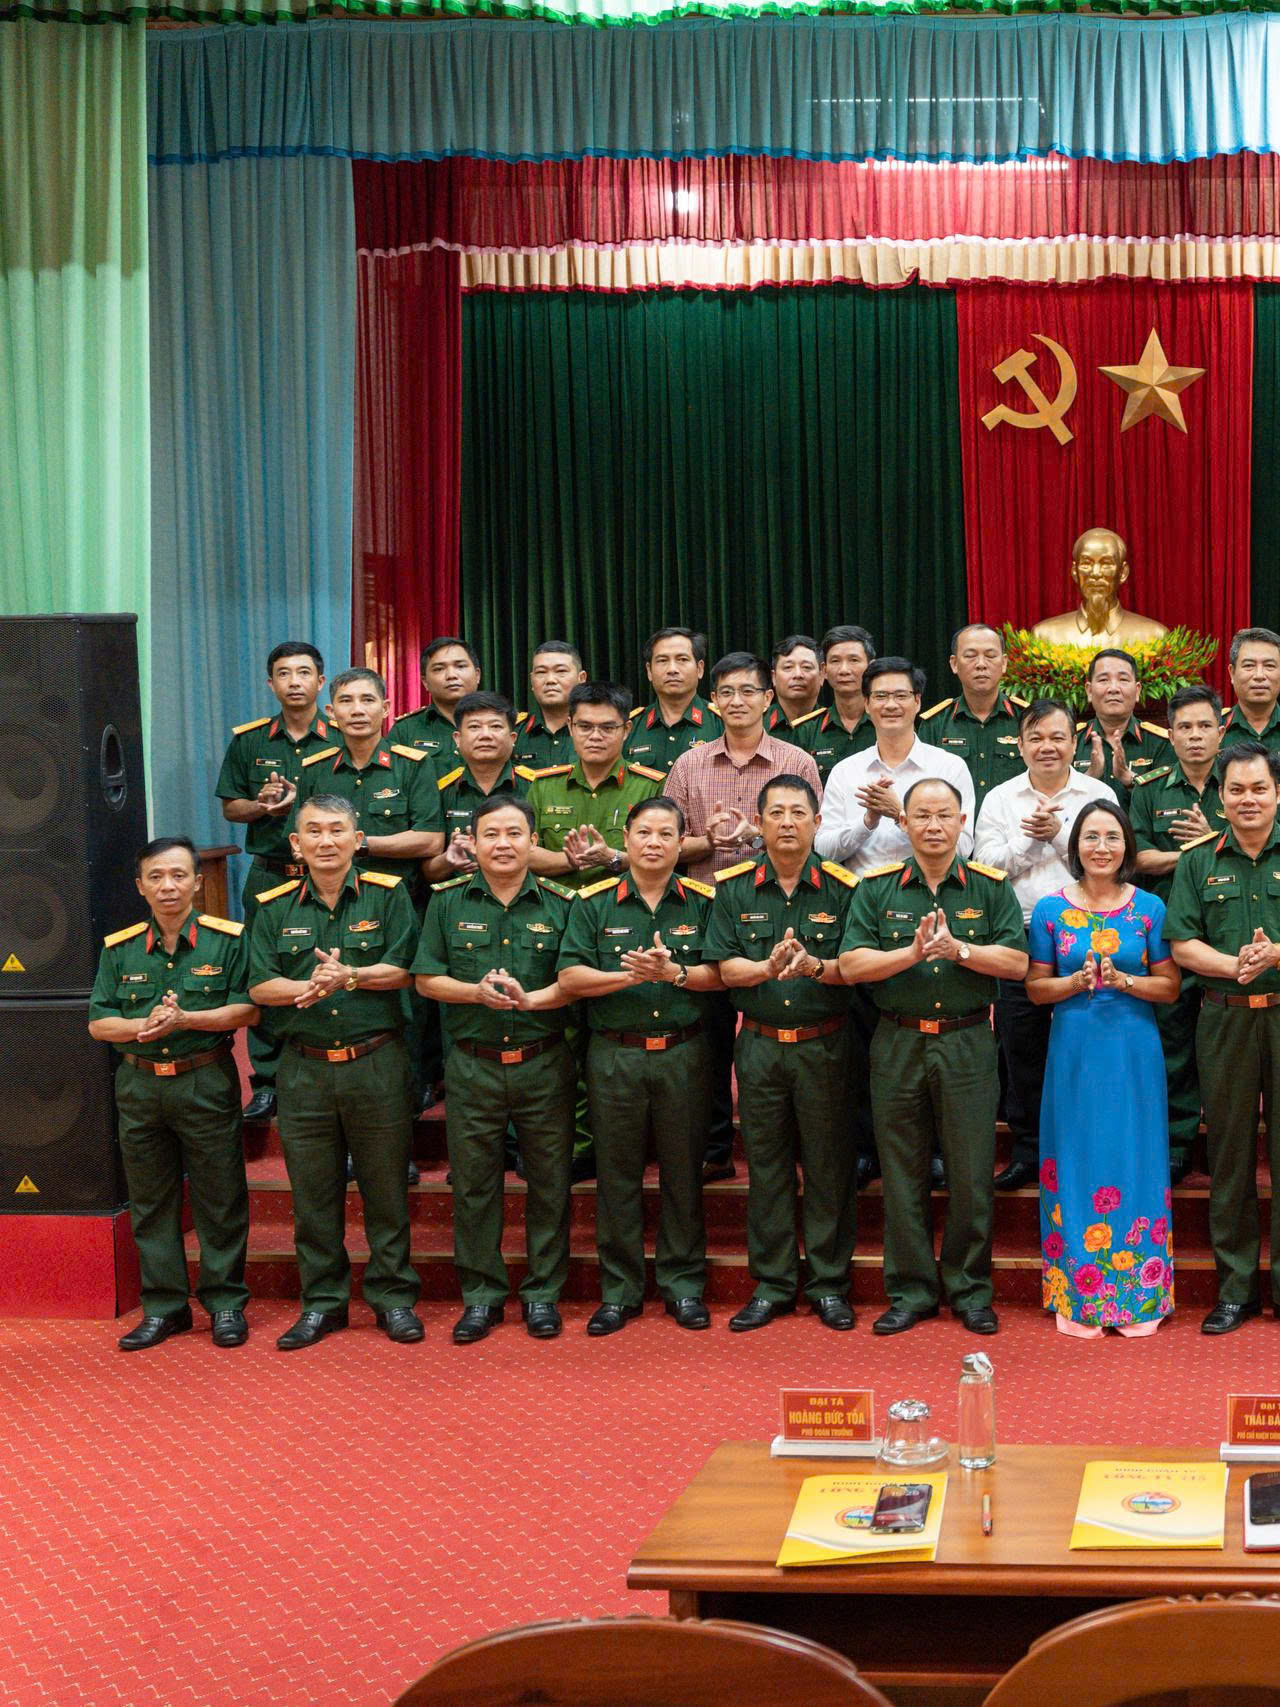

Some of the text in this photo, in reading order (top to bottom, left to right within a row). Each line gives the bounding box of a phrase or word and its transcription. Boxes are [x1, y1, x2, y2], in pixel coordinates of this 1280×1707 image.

[789, 1409, 822, 1424] HOÀNG
[824, 1409, 845, 1424] ĐỨC
[1244, 1413, 1265, 1426] THÁI
[1268, 1413, 1280, 1426] BÁ
